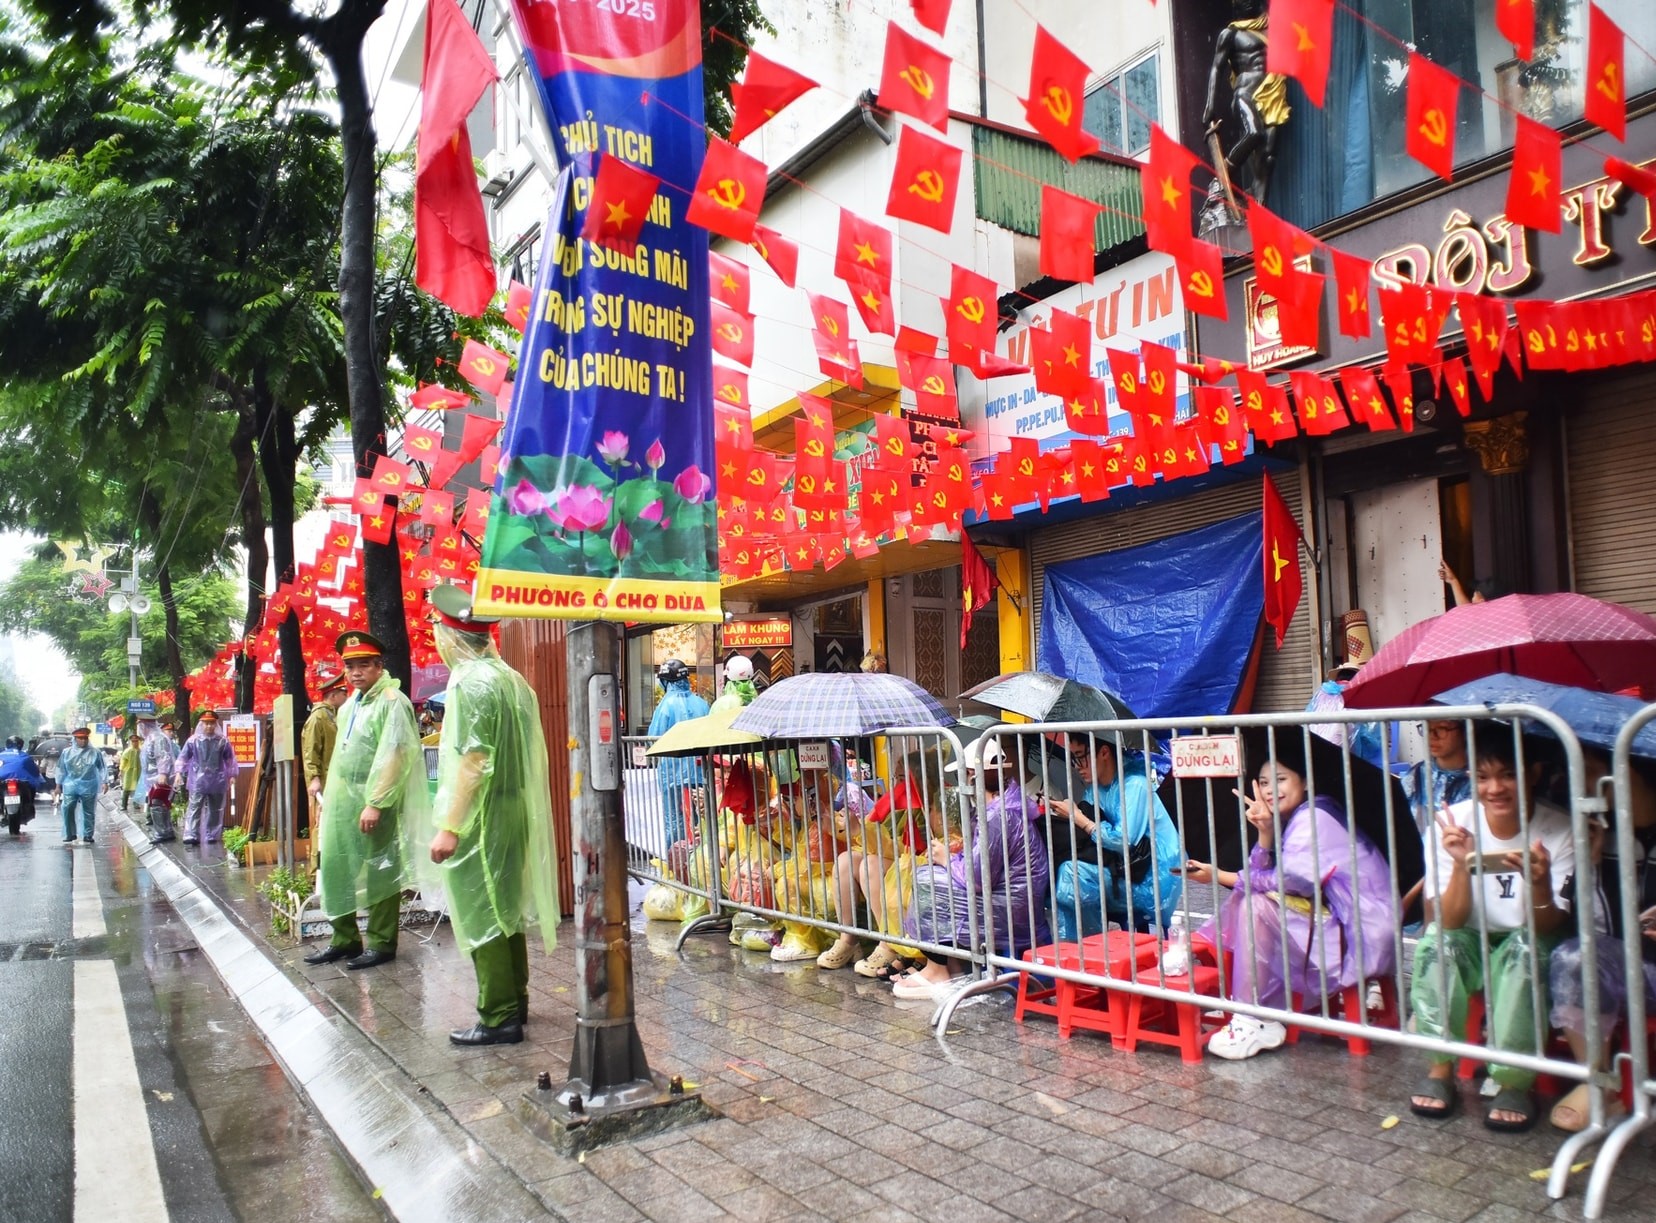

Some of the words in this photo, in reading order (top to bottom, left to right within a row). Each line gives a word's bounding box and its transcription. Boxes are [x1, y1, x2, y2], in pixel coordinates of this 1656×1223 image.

[597, 0, 656, 21] 2025
[654, 250, 688, 290] MÃI
[1132, 265, 1175, 328] IN
[592, 293, 624, 336] SỰ
[628, 299, 695, 352] NGHIỆP
[539, 345, 580, 391] CỦA
[582, 349, 650, 396] CHÚNG
[656, 365, 677, 401] TA
[1008, 393, 1018, 410] IN
[491, 584, 586, 608] PHƯỜNG
[593, 588, 608, 608] Ô
[615, 592, 659, 613] CHỢ
[665, 591, 706, 611] DỪA
[723, 623, 746, 634] LÀM
[750, 623, 790, 634] KHUNG
[729, 634, 746, 645] LẤY
[748, 636, 773, 645] NGAY
